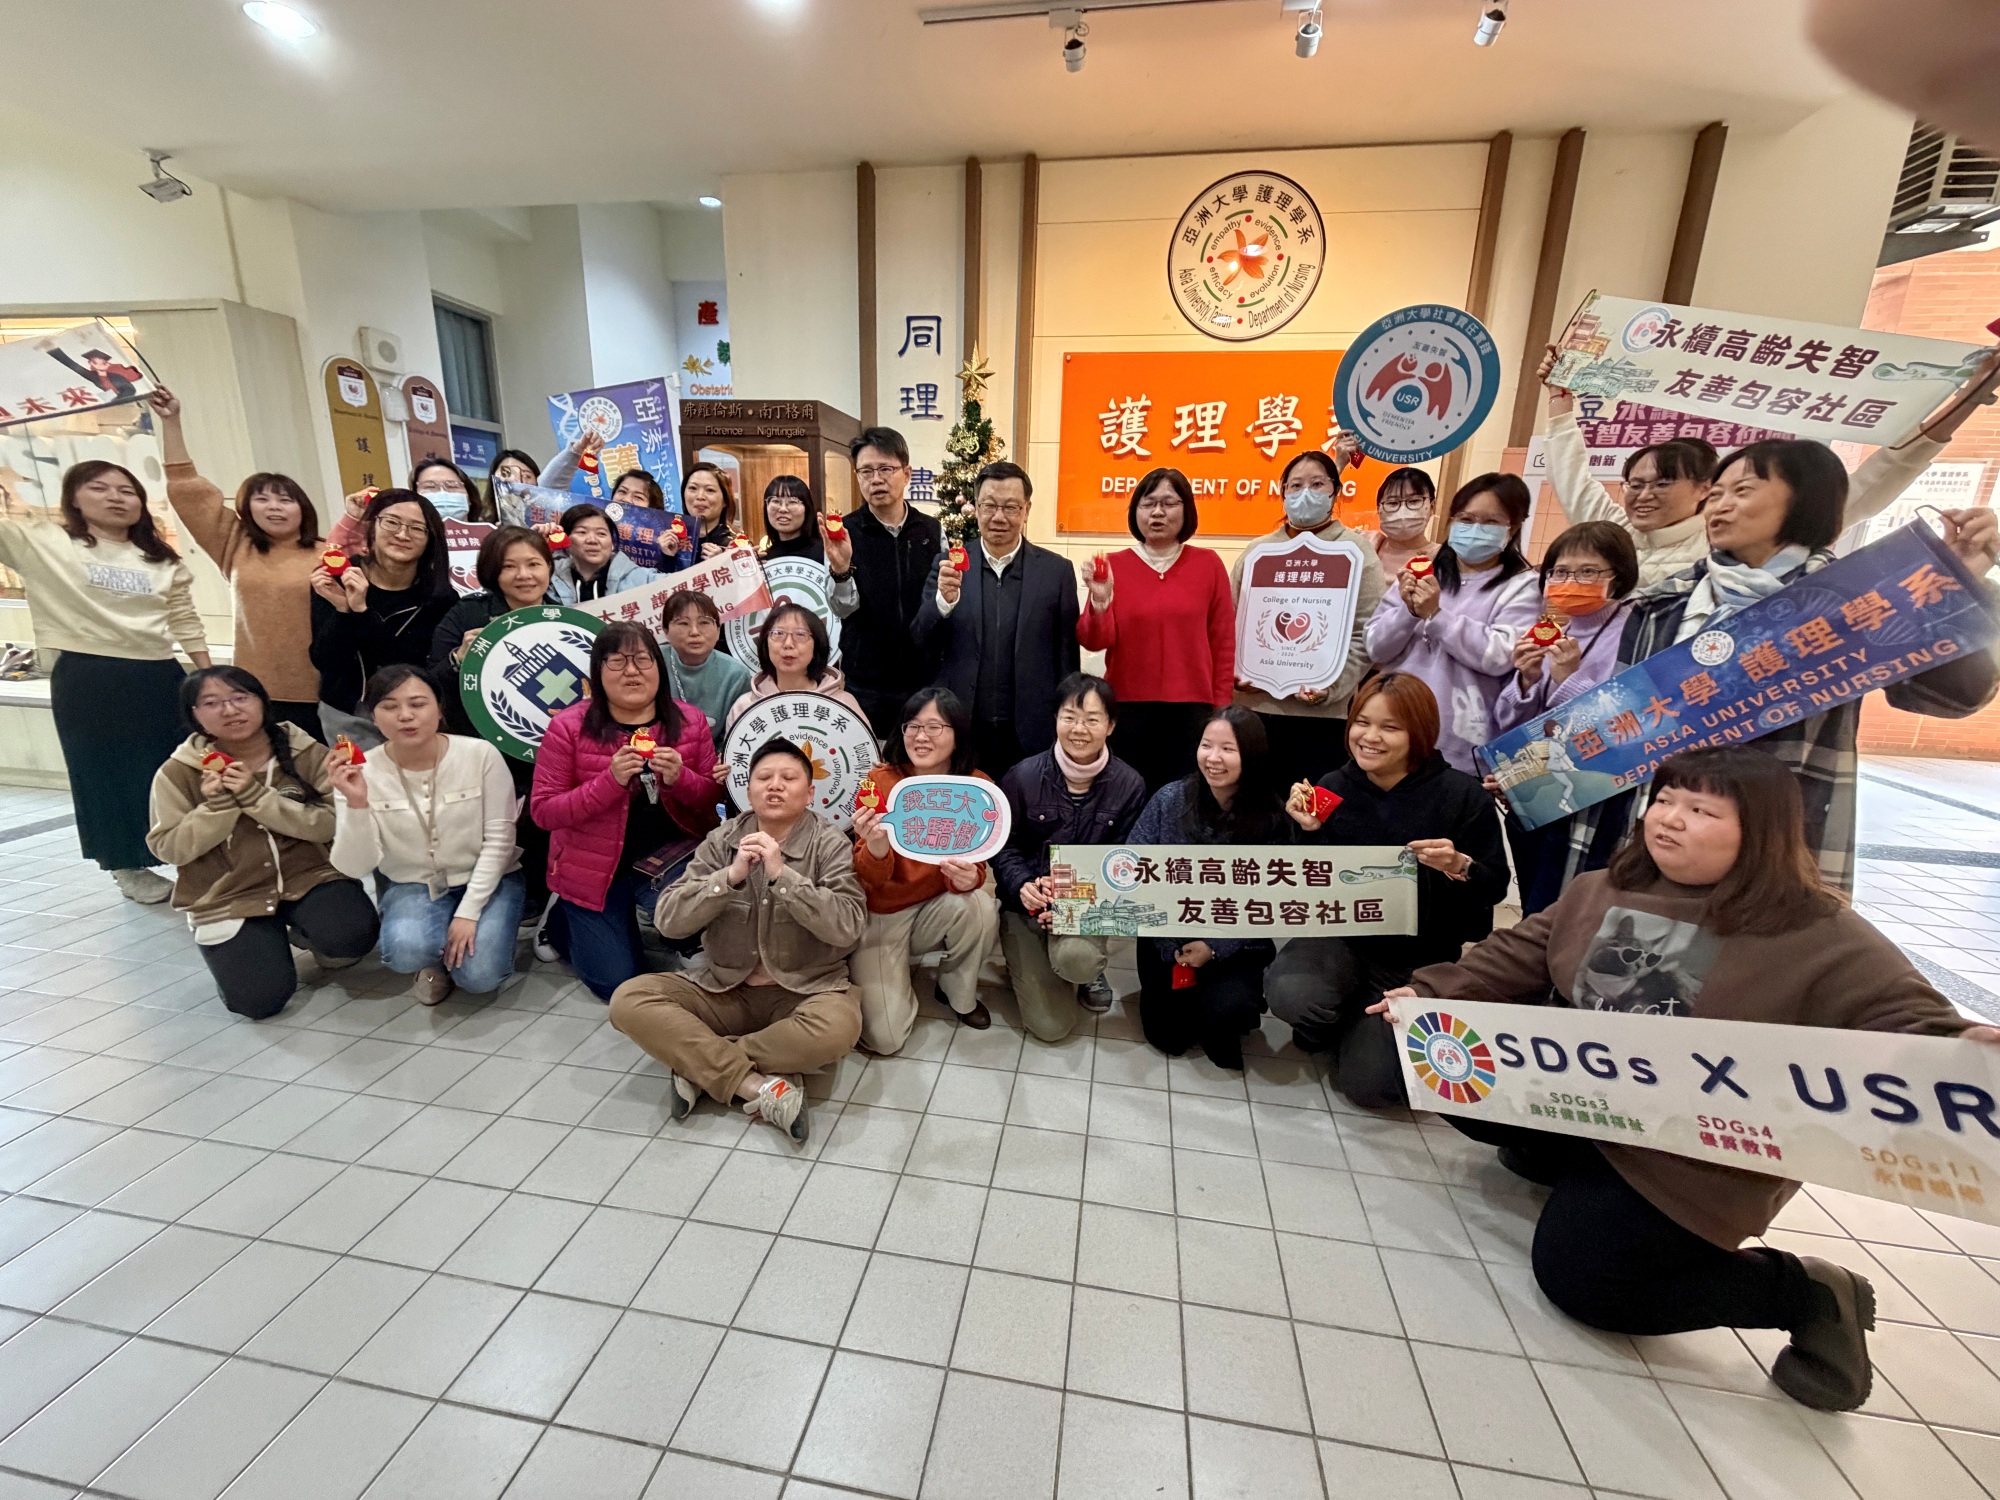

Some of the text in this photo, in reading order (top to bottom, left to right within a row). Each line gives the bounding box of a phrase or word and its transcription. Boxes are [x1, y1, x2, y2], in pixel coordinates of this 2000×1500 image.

[1182, 184, 1315, 246] 亞洲大學 護理學系
[1211, 219, 1242, 250] empathy
[1255, 218, 1282, 251] evidence
[1179, 268, 1196, 286] Asia
[1209, 266, 1233, 299] efficacy
[1250, 264, 1280, 298] evolution
[1248, 263, 1316, 329] Department of Nursing
[1650, 319, 1880, 381] 永續高齡失智
[1396, 392, 1420, 407] USR
[1663, 367, 1898, 429] 友善包容社區
[705, 426, 805, 438] Florence Nightingale
[1367, 445, 1434, 463] UNIVERSITY
[1101, 477, 1228, 494] DEPENT
[1236, 478, 1262, 495] OF
[446, 537, 481, 547] 理學院
[1273, 571, 1325, 583] 護理學院
[1285, 559, 1318, 567] 亞洲大學
[1262, 596, 1332, 606] College of Nursing
[463, 608, 562, 691] 亞洲大學
[1259, 658, 1315, 670] Asia University
[1570, 564, 1963, 760] 亞洲大學 護理學系
[1611, 719, 1755, 788] DEPAMENT
[1765, 701, 1800, 723] OF
[1809, 639, 1959, 706] NURSING
[1644, 724, 1696, 755] ASIA
[1701, 647, 1868, 728] UNIVERSITY
[732, 702, 850, 788] 亞洲大學 護理學系
[789, 732, 829, 750] evidence
[852, 741, 871, 771] Nursing
[829, 757, 842, 795] evolution
[902, 788, 976, 819] 我亞大
[902, 816, 980, 850] 我驕傲
[1133, 856, 1334, 887] 永續高齡失智
[1177, 896, 1385, 926] 友善包容社區
[1495, 1033, 2000, 1139] SDGs X USR
[1550, 1092, 1610, 1111] SDGs3
[1697, 1114, 1773, 1140] SDGs4
[1860, 1146, 1981, 1182] SDGs11
